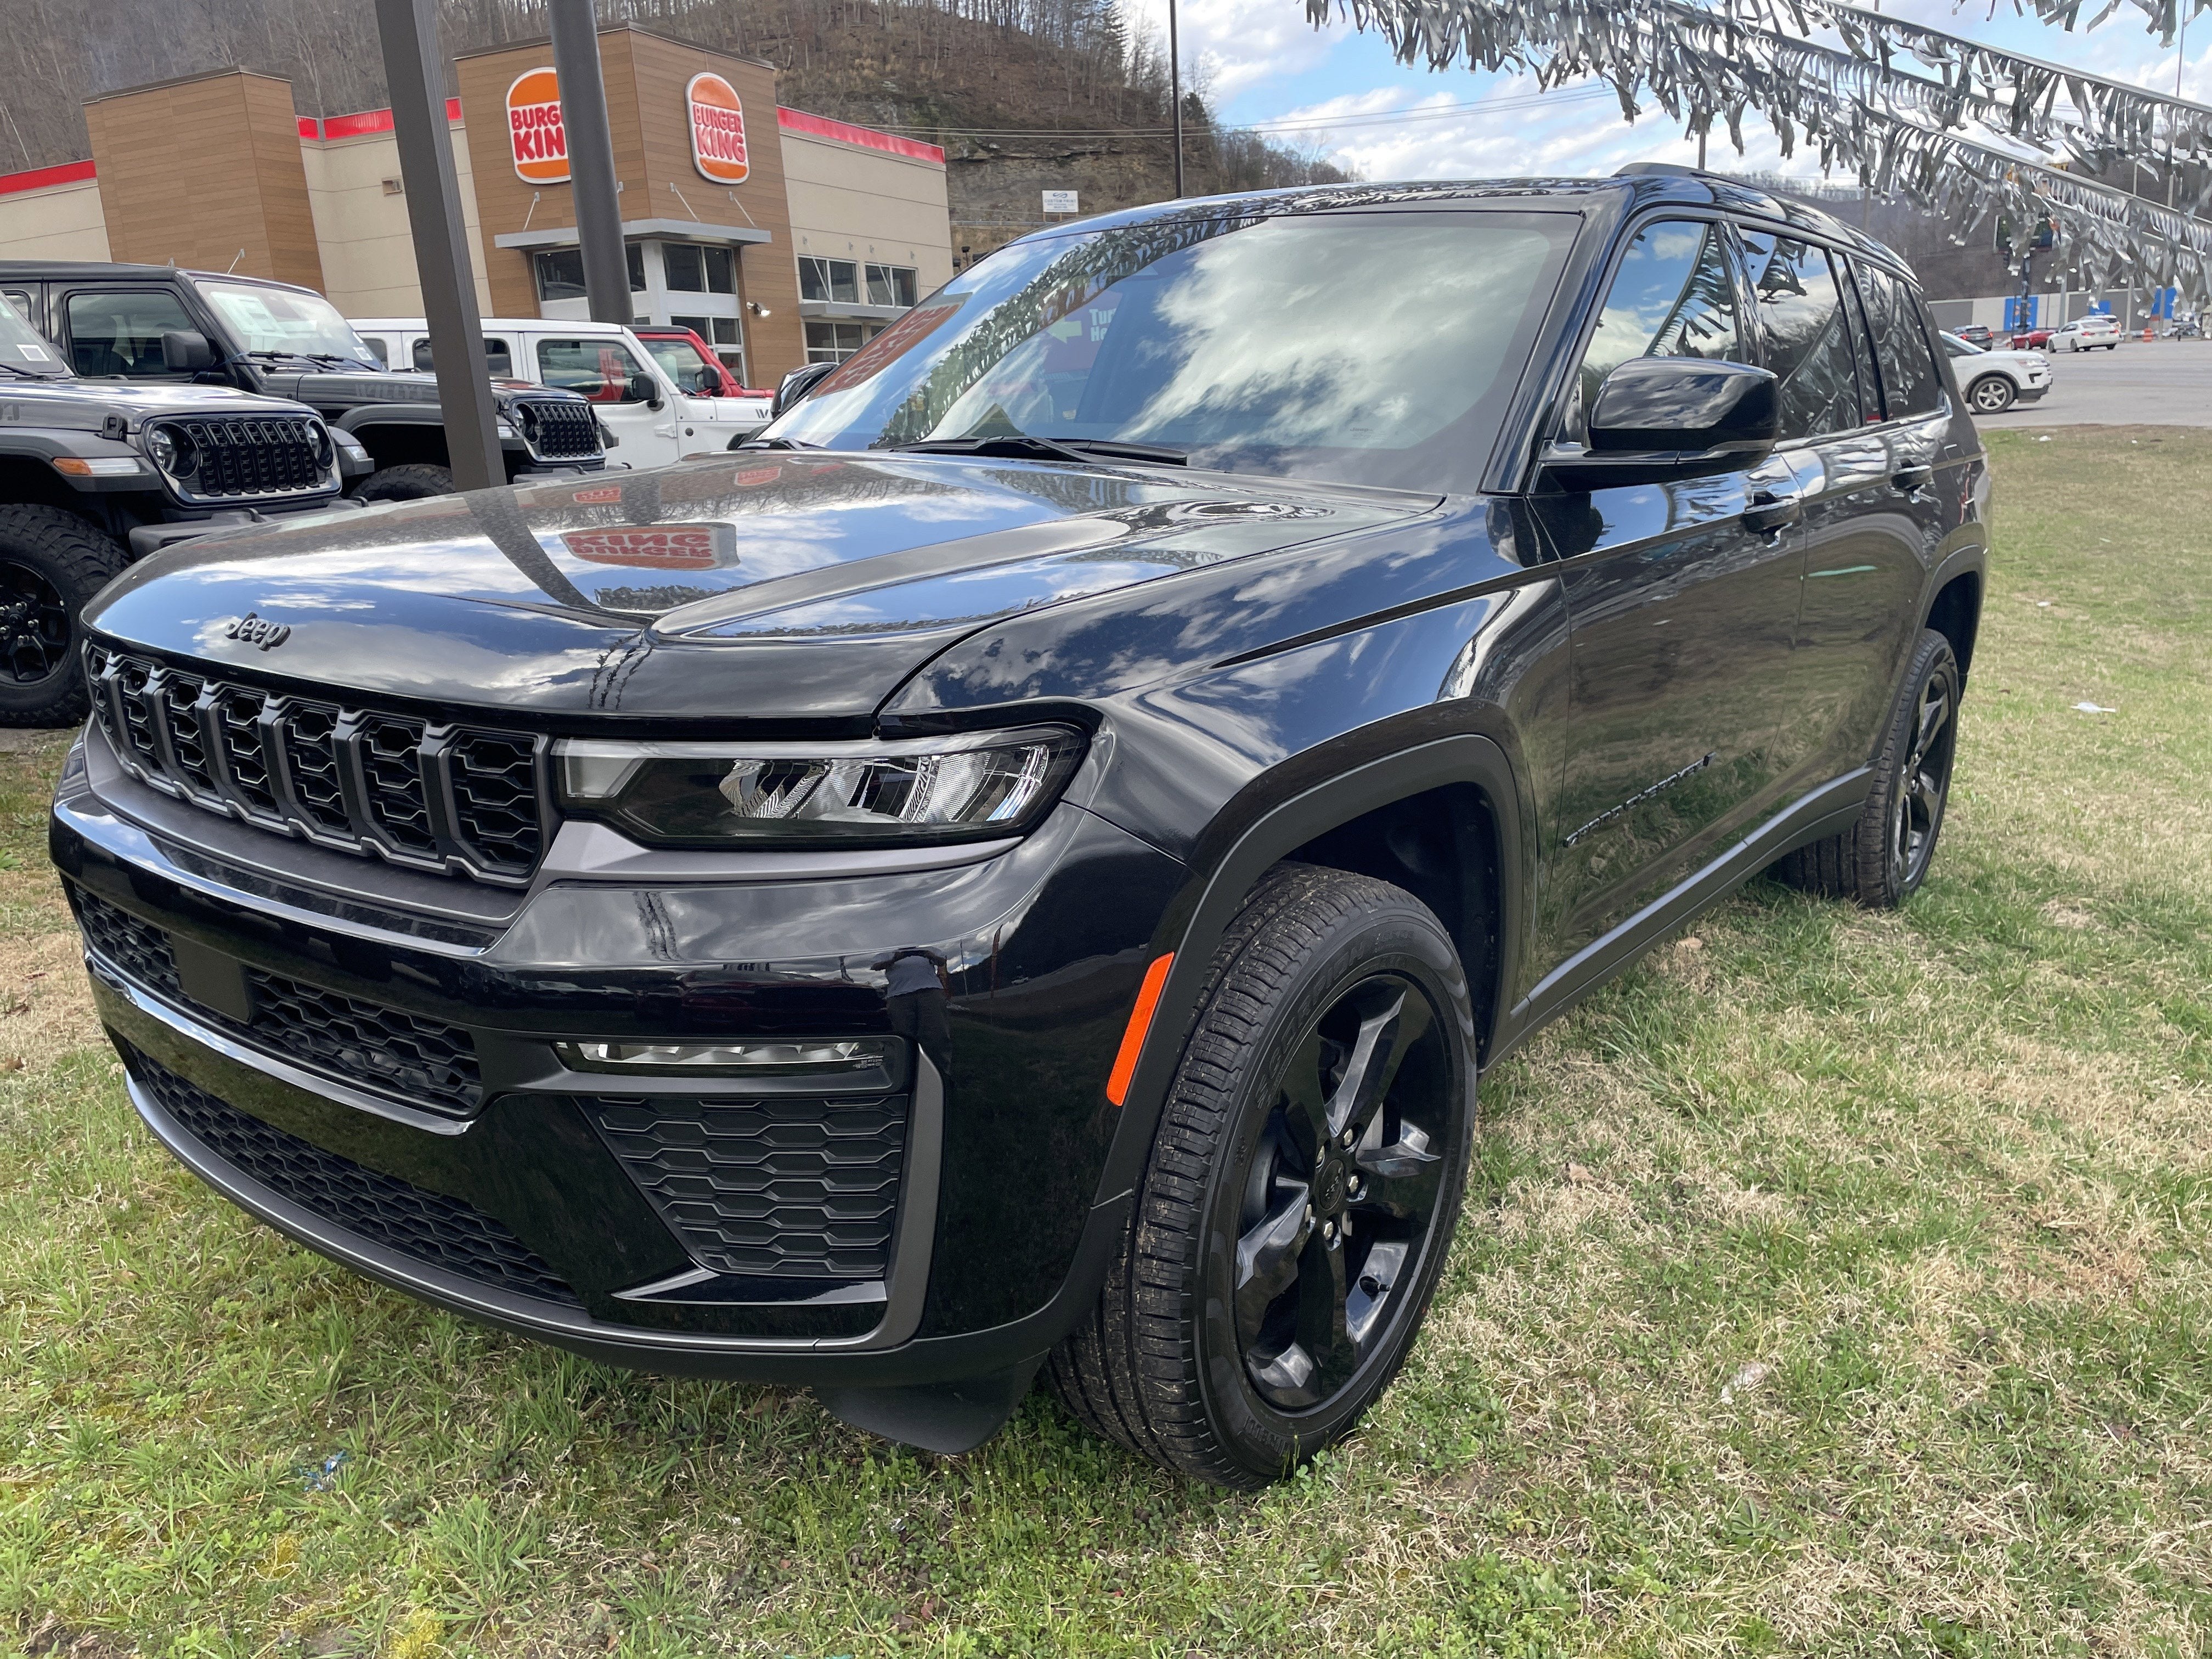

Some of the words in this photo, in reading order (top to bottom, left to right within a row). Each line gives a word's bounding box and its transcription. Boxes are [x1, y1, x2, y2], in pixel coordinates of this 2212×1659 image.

[511, 105, 563, 130] BURG
[693, 104, 743, 133] BURGER
[514, 127, 566, 161] KIN
[696, 126, 746, 162] KING
[1089, 308, 1117, 325] Tur
[1091, 326, 1108, 342] He
[224, 612, 291, 651] Jeep
